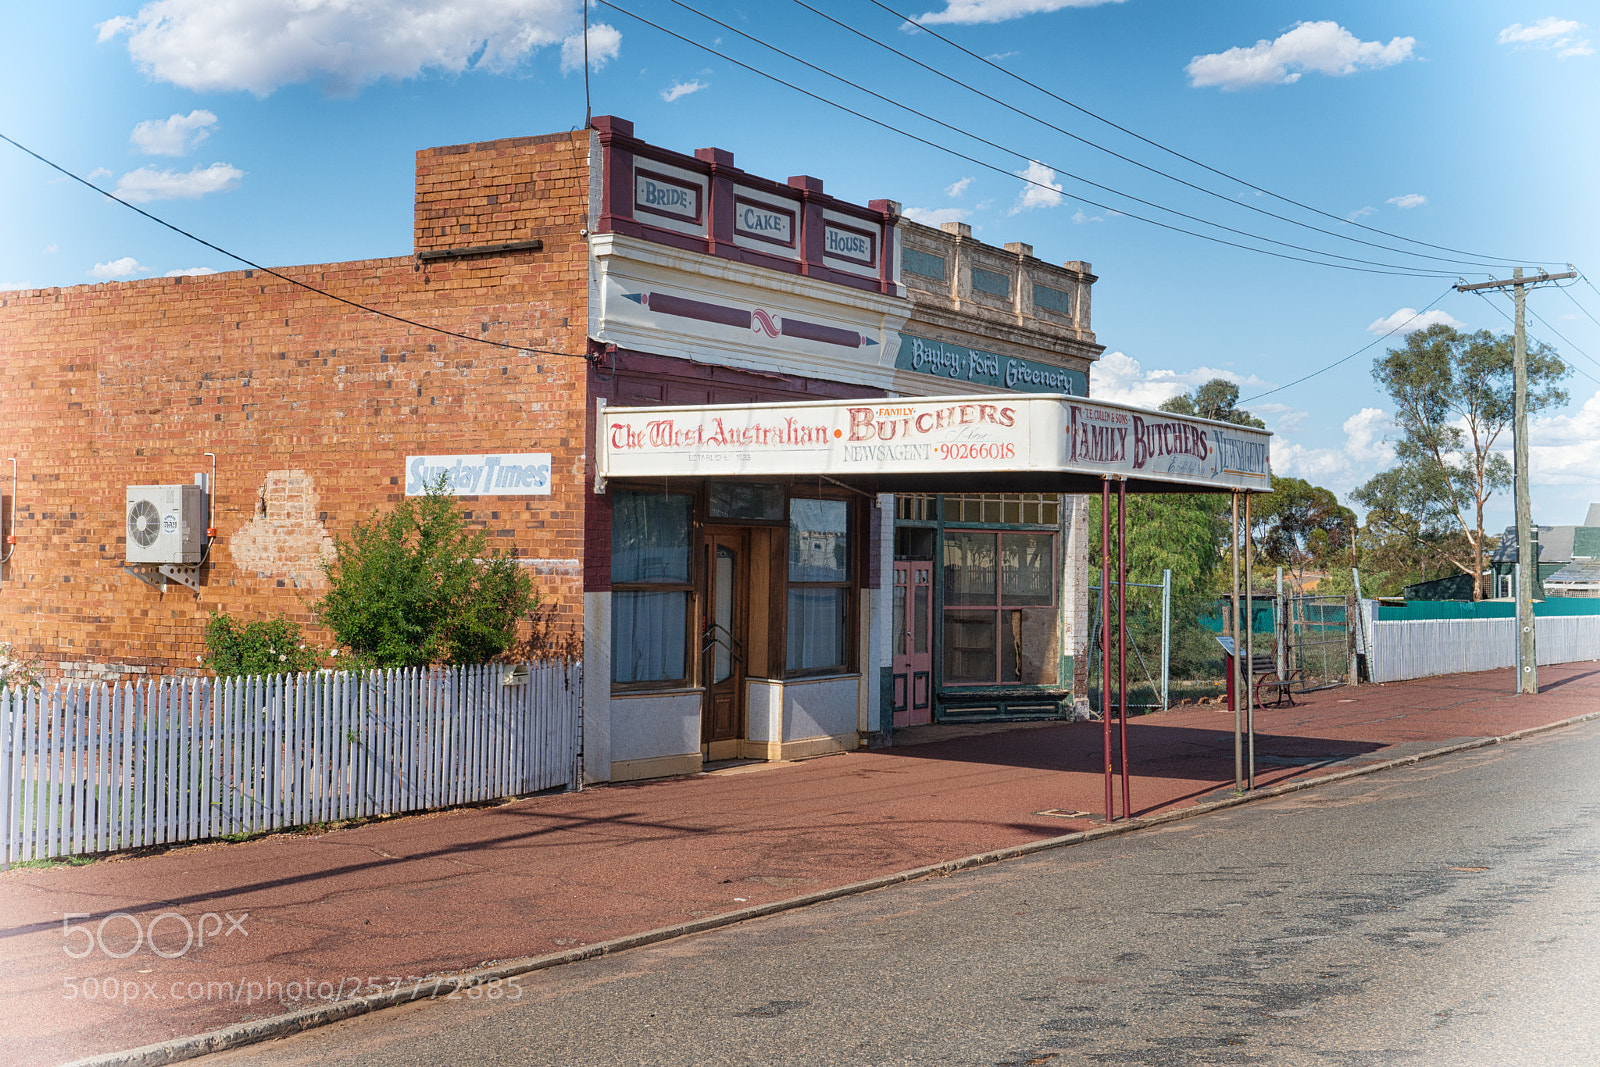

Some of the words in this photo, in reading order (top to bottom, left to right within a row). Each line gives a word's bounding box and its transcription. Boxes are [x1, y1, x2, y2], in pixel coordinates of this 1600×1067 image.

[645, 181, 688, 208] BRIDE
[744, 208, 782, 231] CAKE
[829, 230, 865, 254] HOUSE
[1005, 359, 1073, 395] Greenery
[847, 404, 1017, 441] BUTCHERS
[879, 407, 914, 417] FAMILY
[1115, 413, 1128, 424] SONS
[610, 423, 646, 449] The
[647, 420, 706, 448] West
[706, 417, 829, 447] Australian
[1070, 405, 1128, 462] FAMILY
[1132, 415, 1207, 469] BUTCHERS
[843, 444, 931, 462] NEWSAGENT
[941, 443, 1015, 460] 90266018
[1211, 430, 1265, 478] NEWSAGENT
